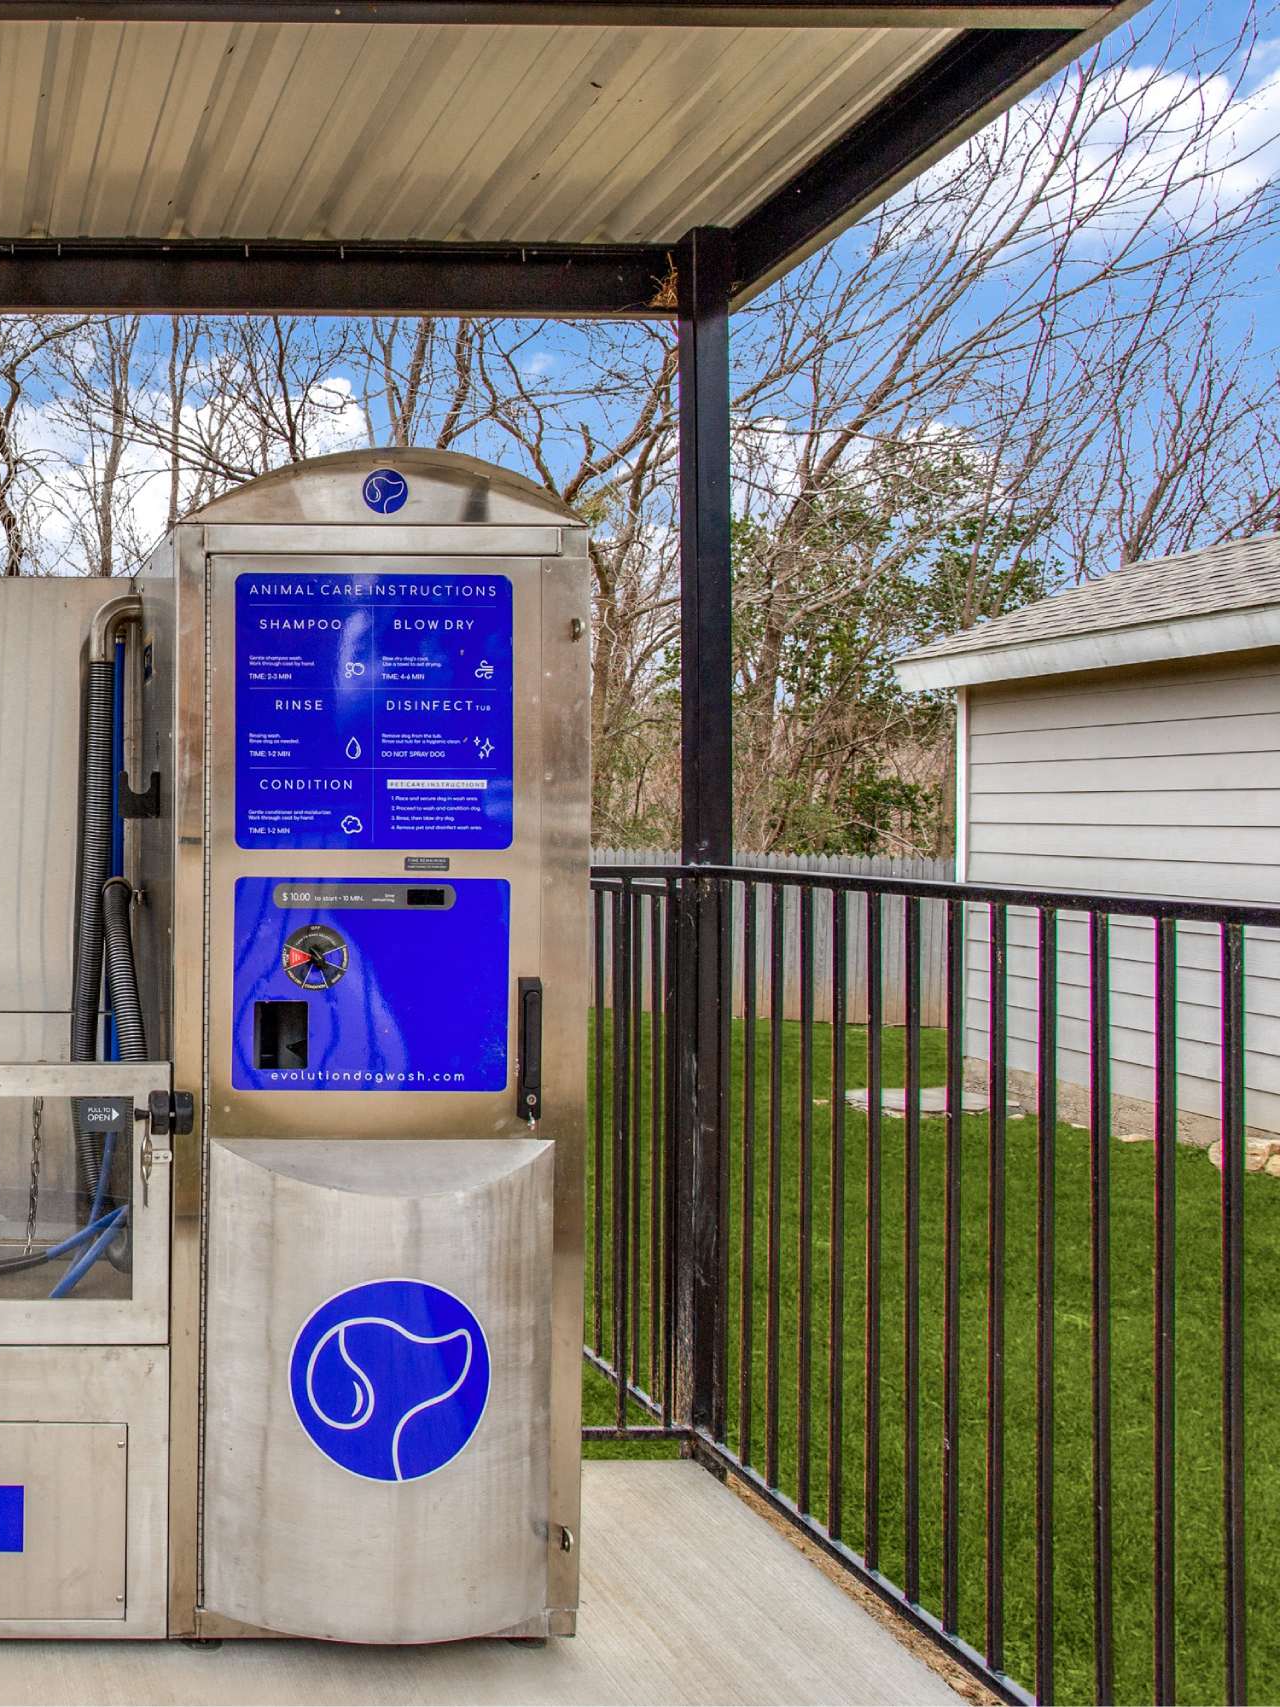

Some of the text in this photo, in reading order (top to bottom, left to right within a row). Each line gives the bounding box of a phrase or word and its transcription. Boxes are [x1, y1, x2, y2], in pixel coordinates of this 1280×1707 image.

[249, 584, 497, 597] ANIMAL CARE INSTRUCTIONS
[259, 619, 342, 630] SHAMPOO
[394, 619, 475, 630] BLOW DRY
[275, 700, 324, 711] RINSE
[386, 700, 473, 711] DISINFECT
[259, 779, 354, 790] CONDITION
[282, 892, 289, 902] $
[290, 892, 311, 901] 10.00
[271, 1070, 466, 1083] evolutiondogwash.com
